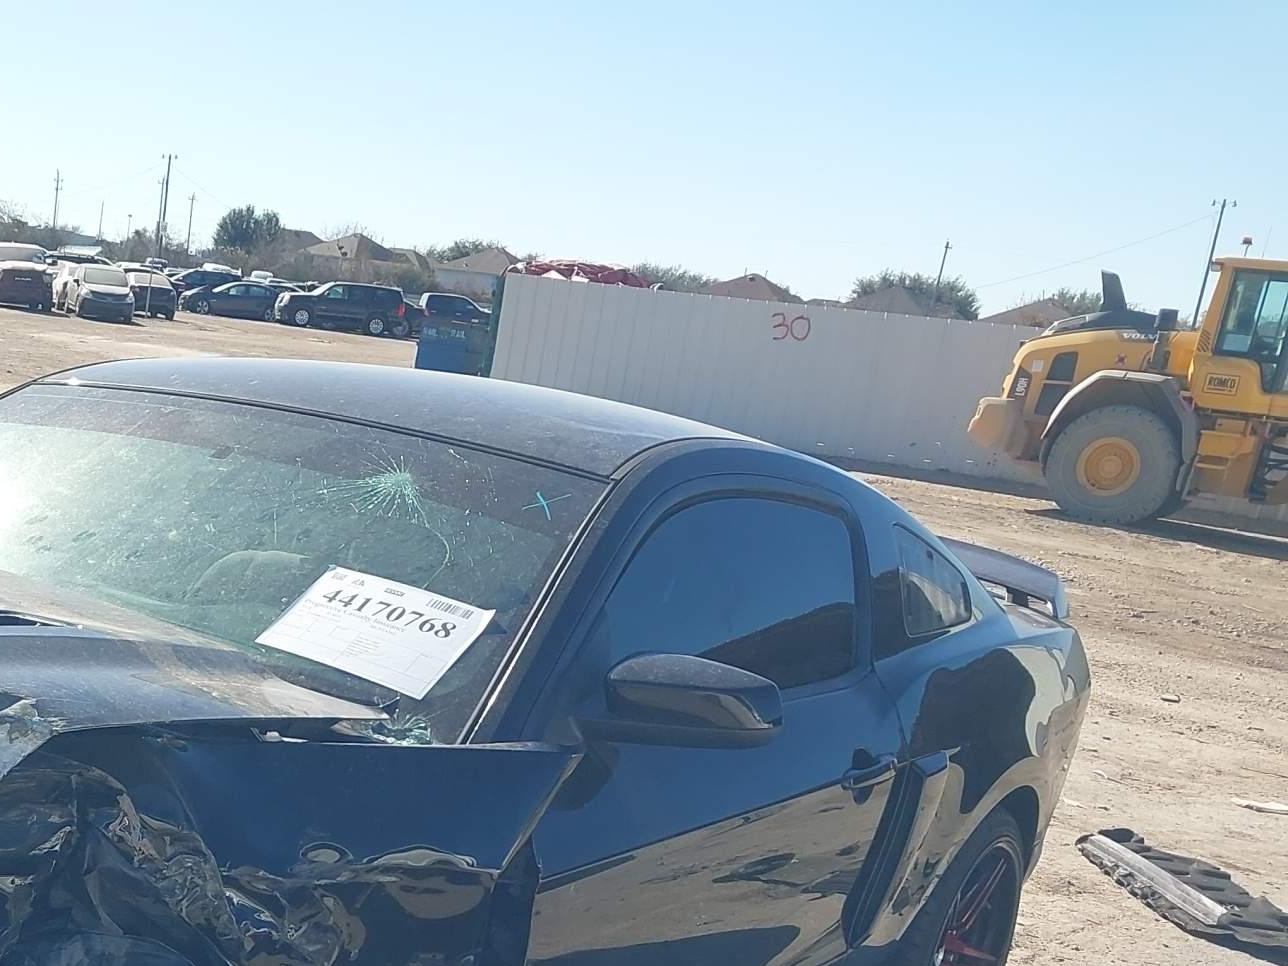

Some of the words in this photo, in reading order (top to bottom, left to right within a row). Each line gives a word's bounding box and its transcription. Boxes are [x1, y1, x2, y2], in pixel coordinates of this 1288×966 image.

[772, 312, 811, 341] 30
[1208, 375, 1236, 389] ROMCO
[322, 588, 457, 639] 44170768
